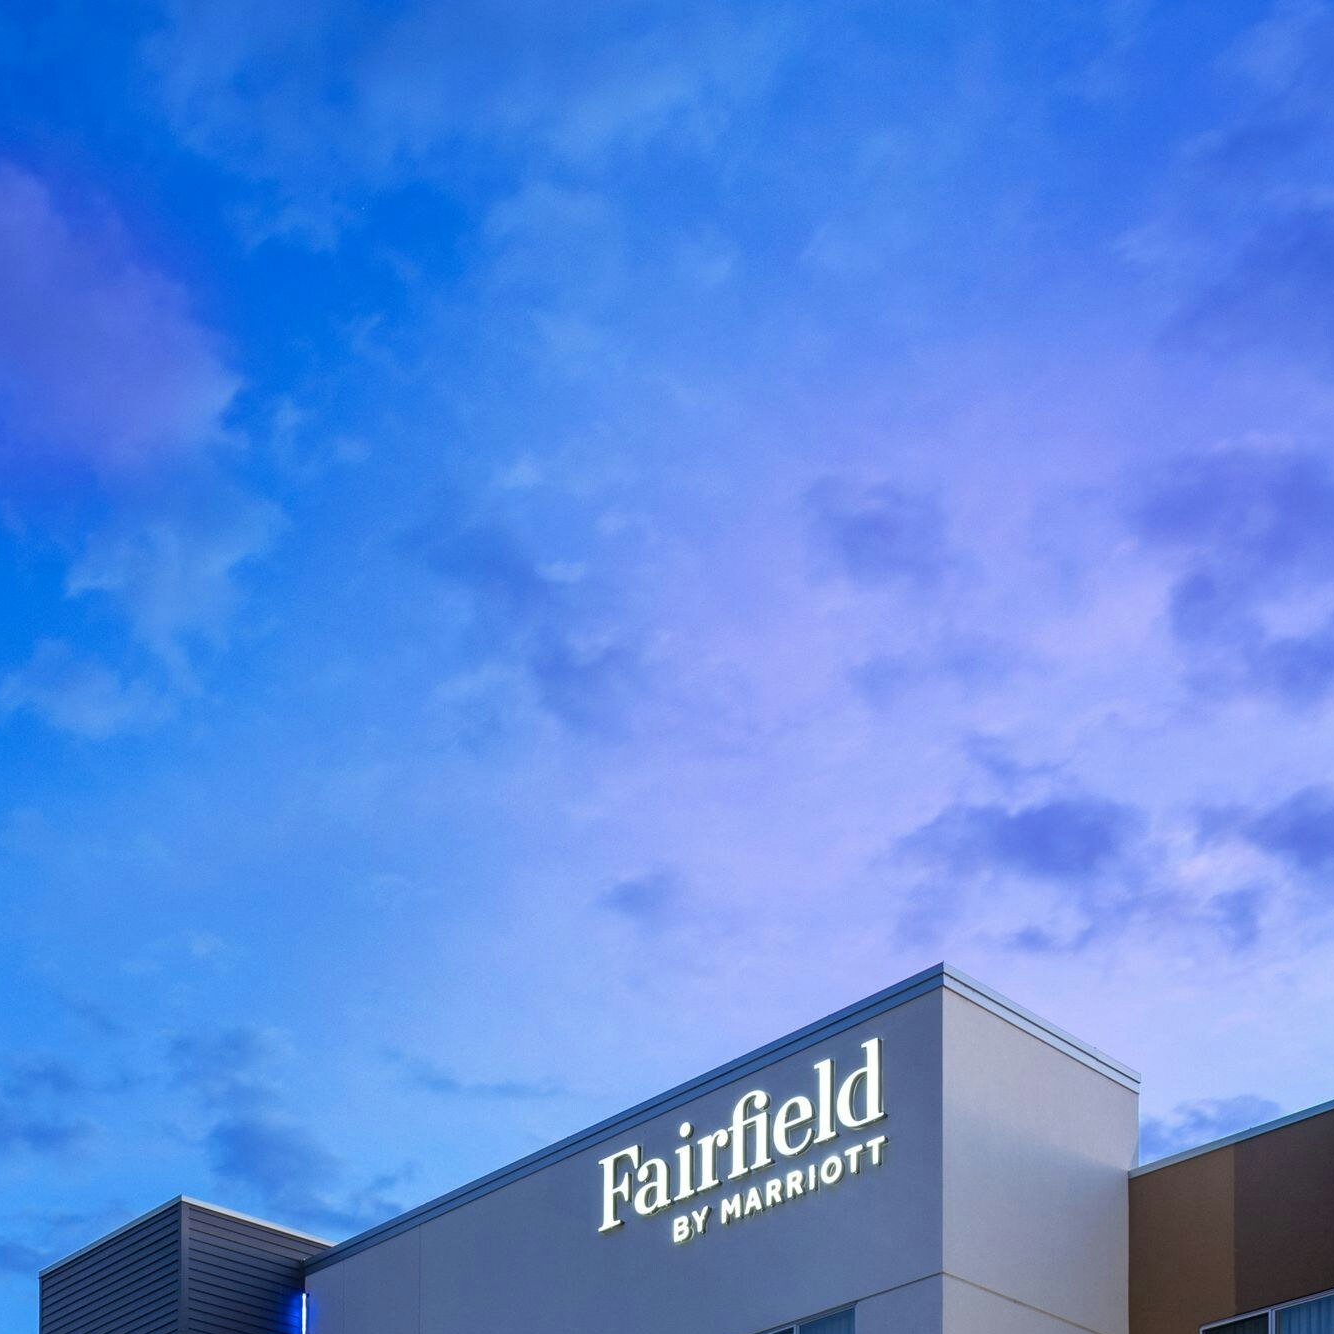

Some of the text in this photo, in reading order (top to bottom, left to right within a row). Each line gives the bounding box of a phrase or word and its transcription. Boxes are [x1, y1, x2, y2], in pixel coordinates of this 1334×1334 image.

[598, 1037, 886, 1232] Fairfield
[673, 1135, 888, 1243] BY MARRIOTT
